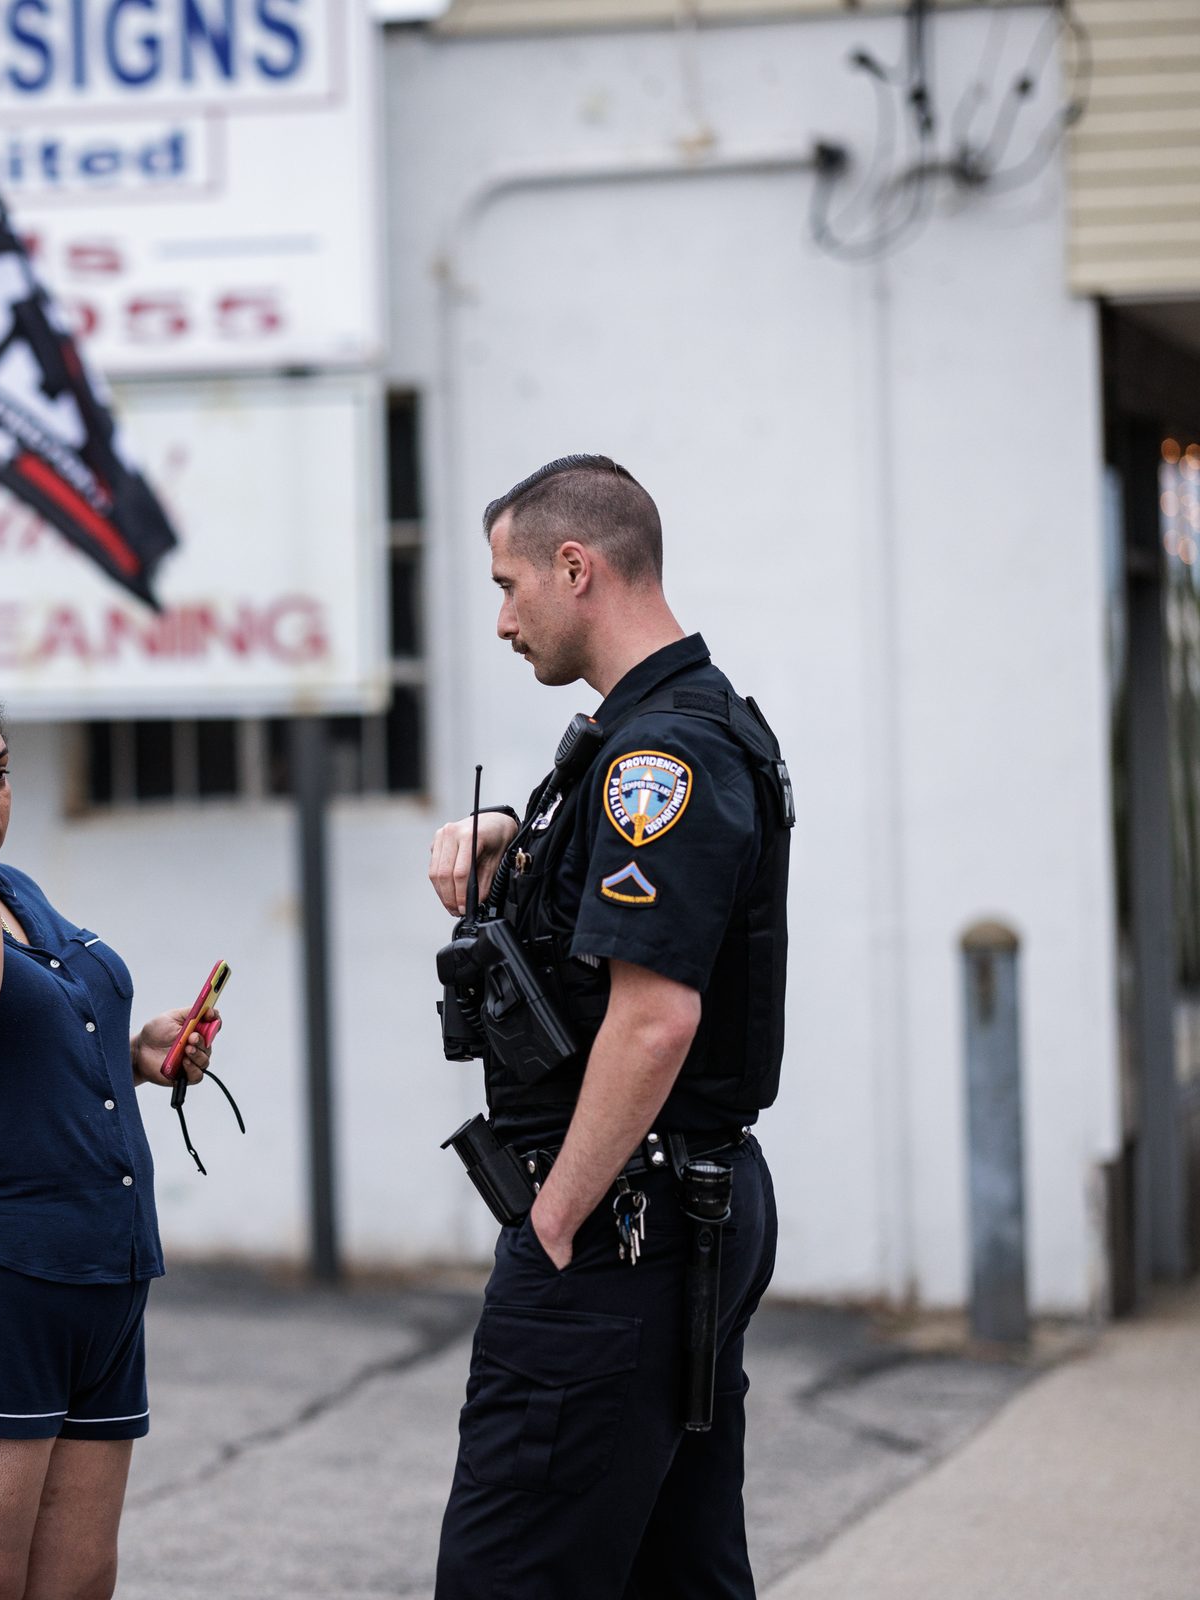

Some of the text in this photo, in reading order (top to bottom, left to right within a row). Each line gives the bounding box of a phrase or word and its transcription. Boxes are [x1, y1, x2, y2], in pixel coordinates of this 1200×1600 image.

[618, 755, 685, 778] PROVIDENCE
[608, 777, 631, 827] POLICE
[643, 778, 688, 836] DEPARTMENT
